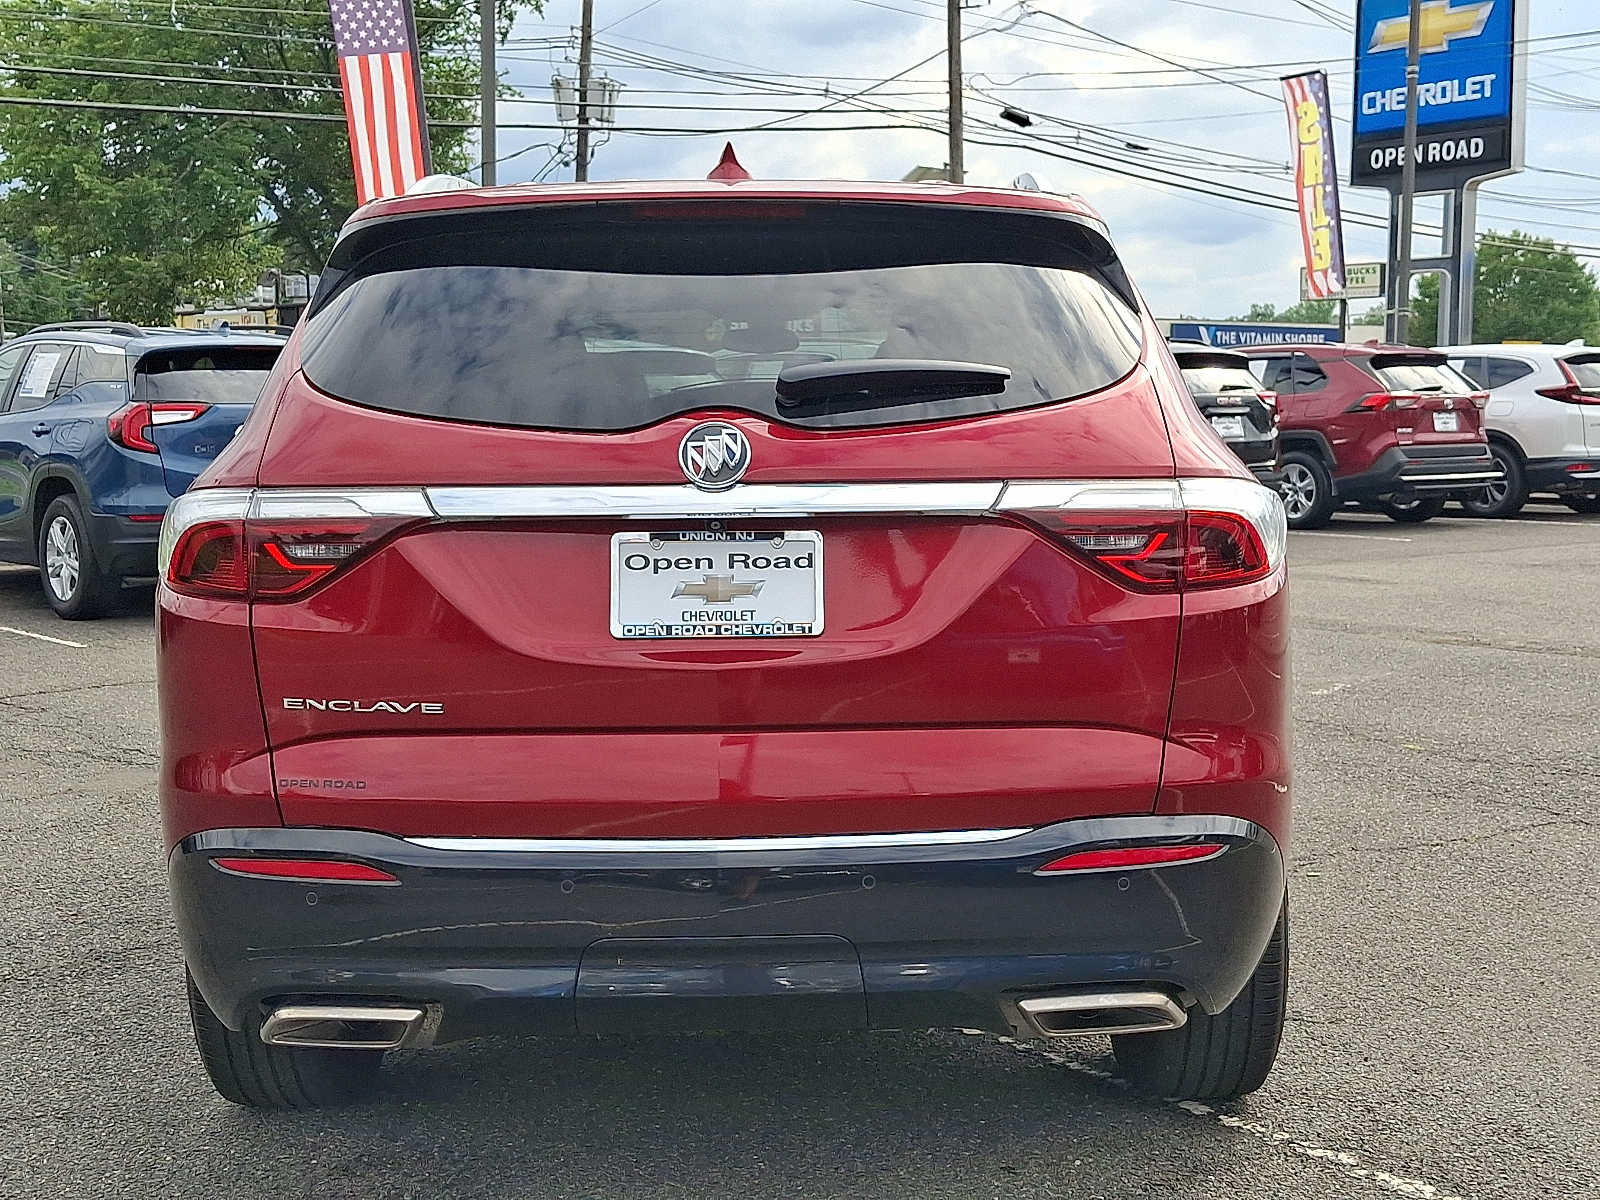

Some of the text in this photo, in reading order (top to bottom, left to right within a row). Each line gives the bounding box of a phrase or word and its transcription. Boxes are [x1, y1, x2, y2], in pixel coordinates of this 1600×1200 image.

[1362, 74, 1497, 115] CHEROLET
[1428, 137, 1484, 163] ROAD
[1346, 267, 1377, 276] BUCKS
[1216, 331, 1237, 344] THE
[1239, 332, 1283, 345] VITAMIN
[735, 531, 755, 540] NJ
[624, 552, 814, 574] Open Road
[681, 609, 756, 622] CHEVROLET
[623, 622, 811, 636] OPEN ROAD CHEVROLET
[283, 697, 444, 714] ENCLAVE
[279, 778, 367, 790] OPEN ROAD
